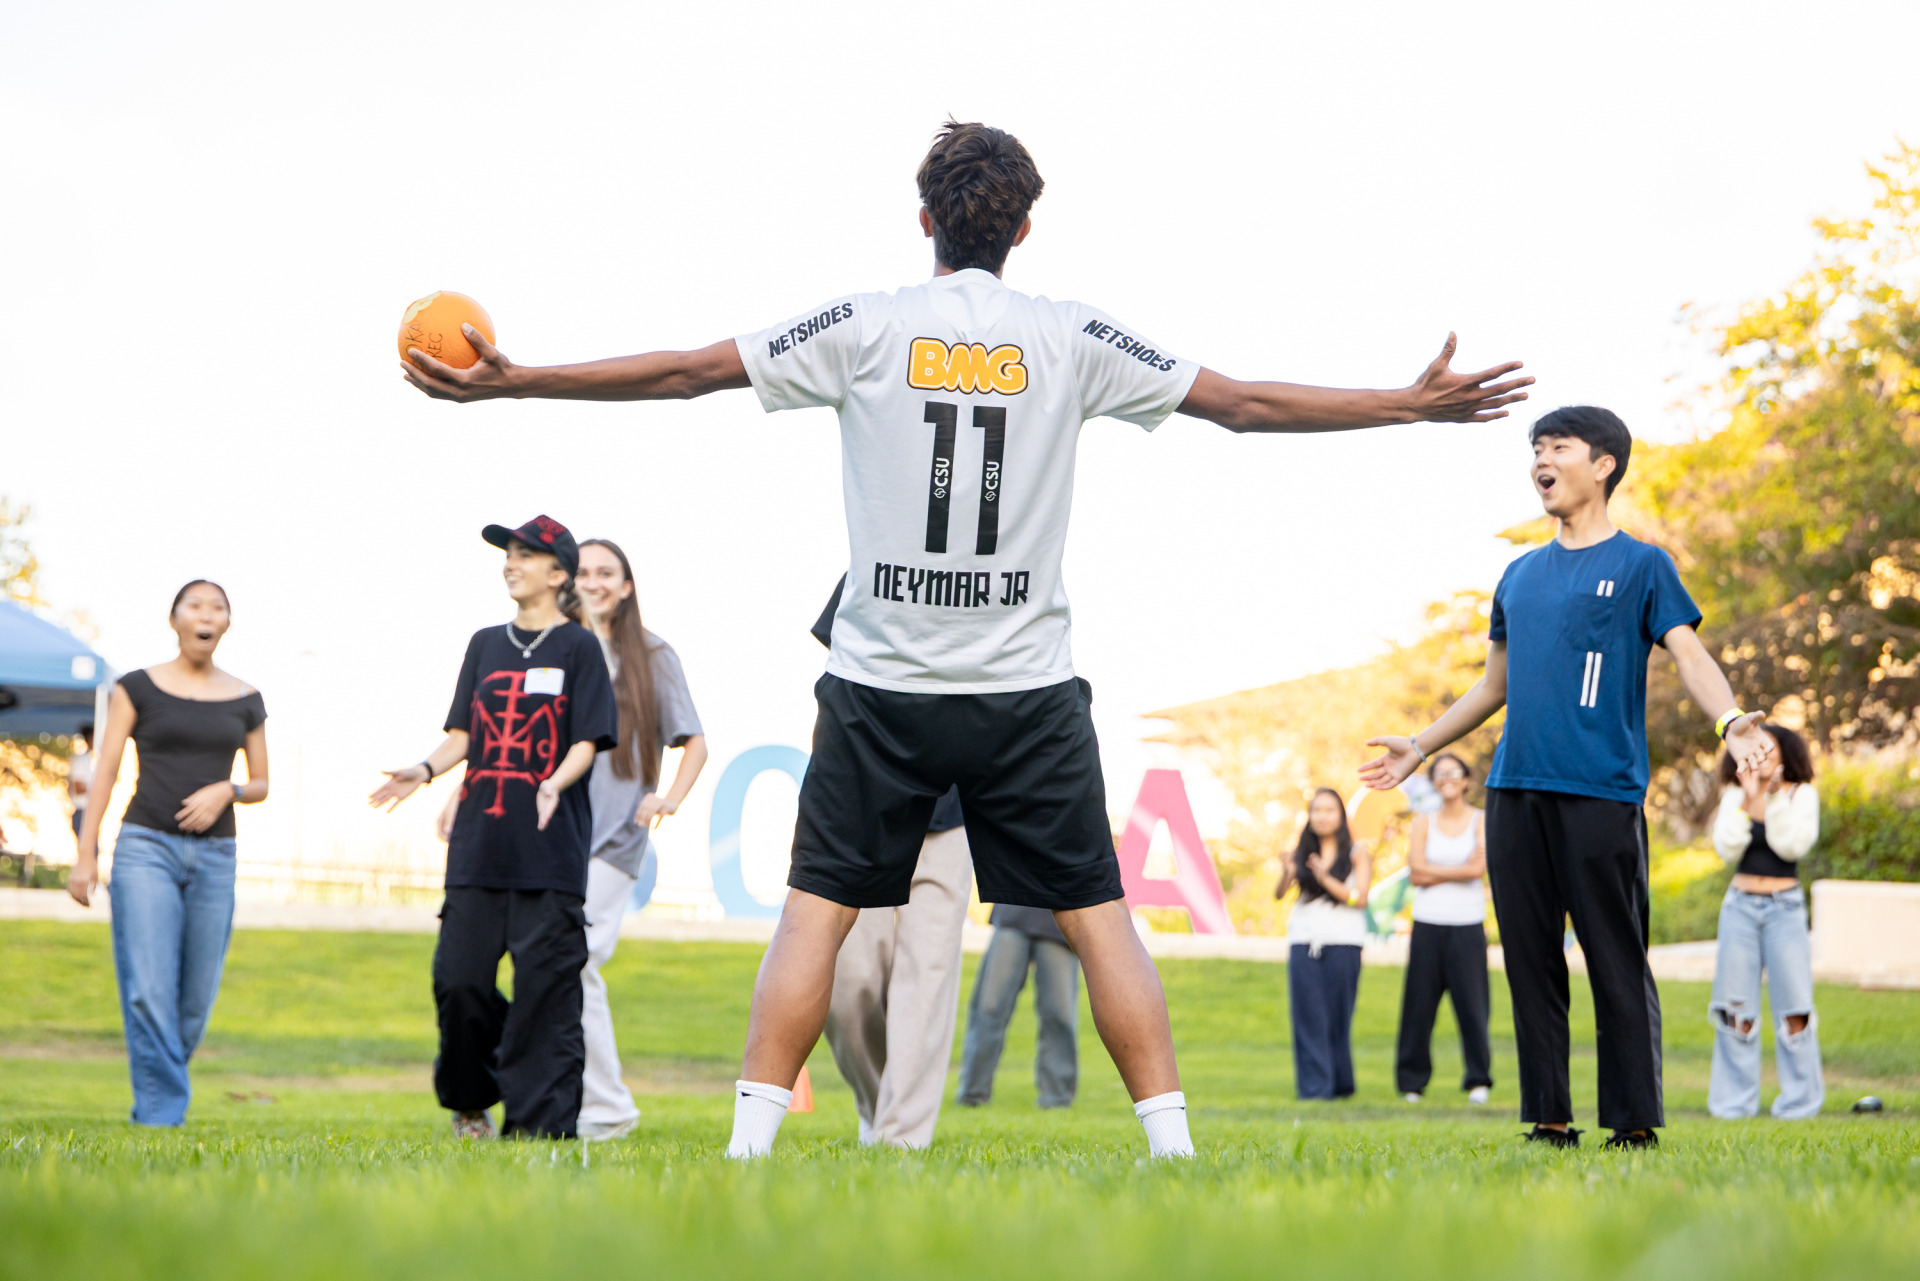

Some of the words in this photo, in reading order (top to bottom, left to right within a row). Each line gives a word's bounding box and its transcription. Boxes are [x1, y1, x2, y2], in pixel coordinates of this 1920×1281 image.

[425, 332, 443, 359] REC
[768, 302, 853, 359] NETSHOES
[1082, 319, 1177, 372] NETSHOES
[907, 337, 1029, 395] BMG
[924, 401, 1006, 555] 11
[934, 457, 950, 487] CSU
[985, 461, 1000, 490] CSU
[873, 562, 991, 608] NEYMAR
[1000, 571, 1030, 606] JR
